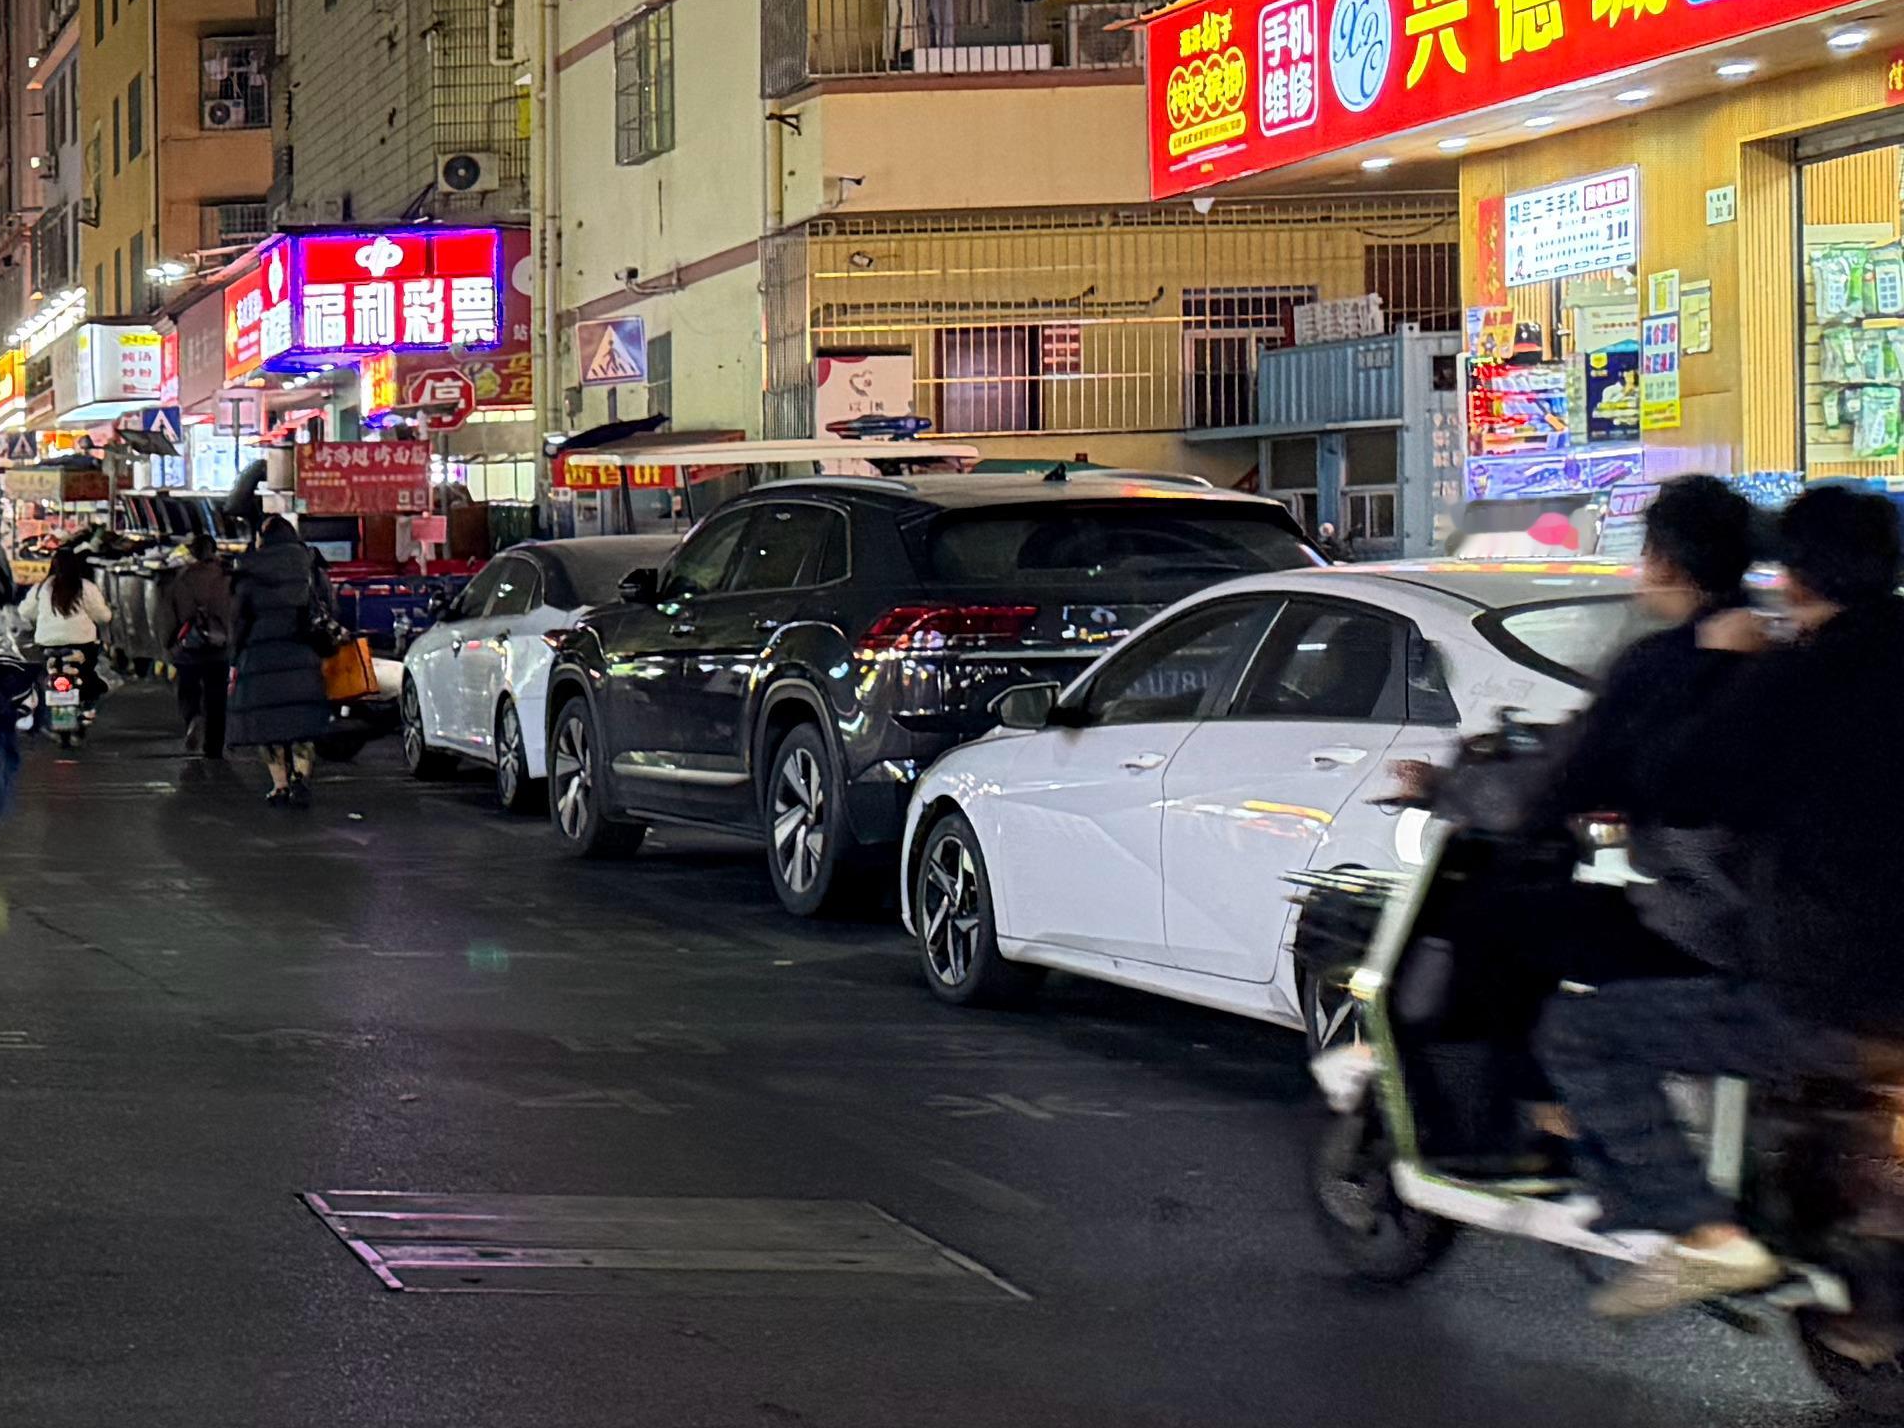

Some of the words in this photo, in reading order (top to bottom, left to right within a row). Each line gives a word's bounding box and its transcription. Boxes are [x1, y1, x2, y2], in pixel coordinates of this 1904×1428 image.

[1265, 4, 1313, 66] 手机
[1265, 62, 1313, 123] 维修
[303, 277, 495, 348] 福利彩票
